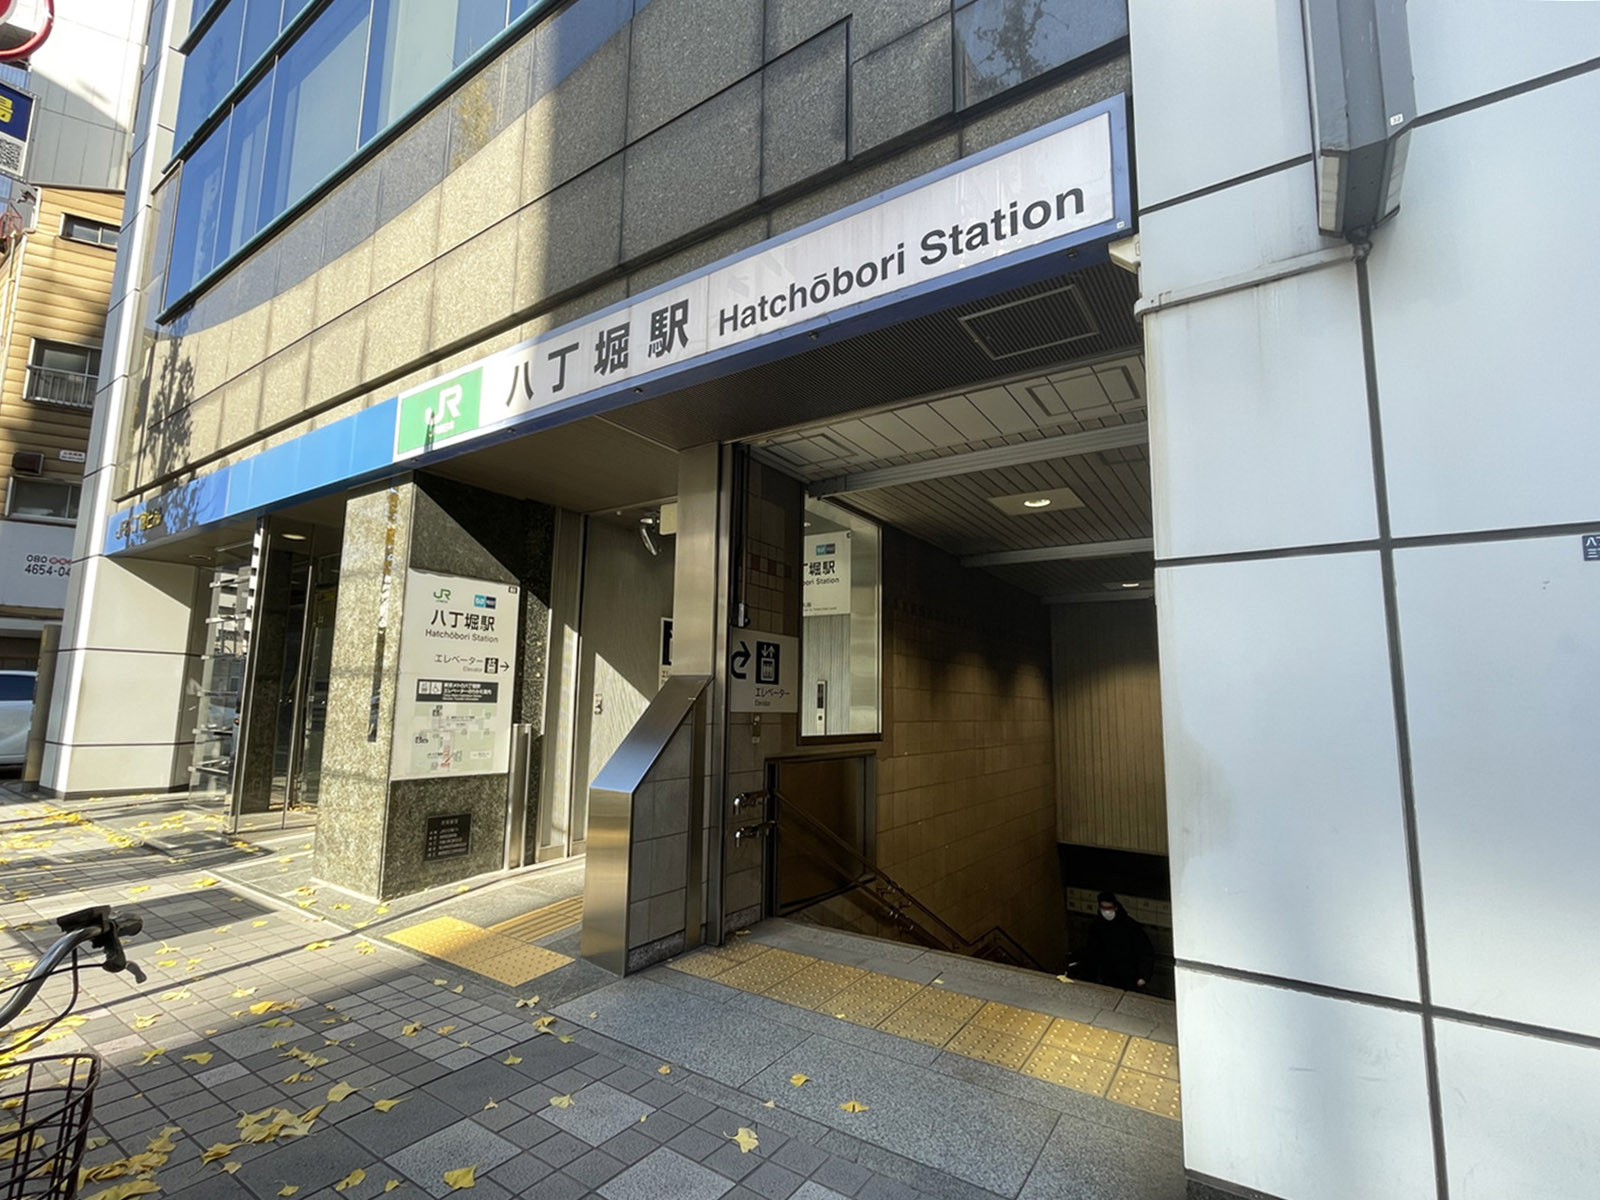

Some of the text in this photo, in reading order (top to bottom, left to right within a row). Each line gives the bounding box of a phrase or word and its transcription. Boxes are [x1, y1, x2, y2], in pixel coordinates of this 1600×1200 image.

[505, 186, 1085, 408] 八丁堀駅 Hatchōbori Station
[425, 383, 462, 424] JR
[26, 554, 48, 564] 080
[815, 577, 840, 585] Station
[433, 588, 452, 600] JR
[430, 609, 496, 632] 八丁堀駅
[471, 633, 499, 643] Station
[434, 654, 484, 666] エレベーター
[754, 687, 791, 699] エレベーター
